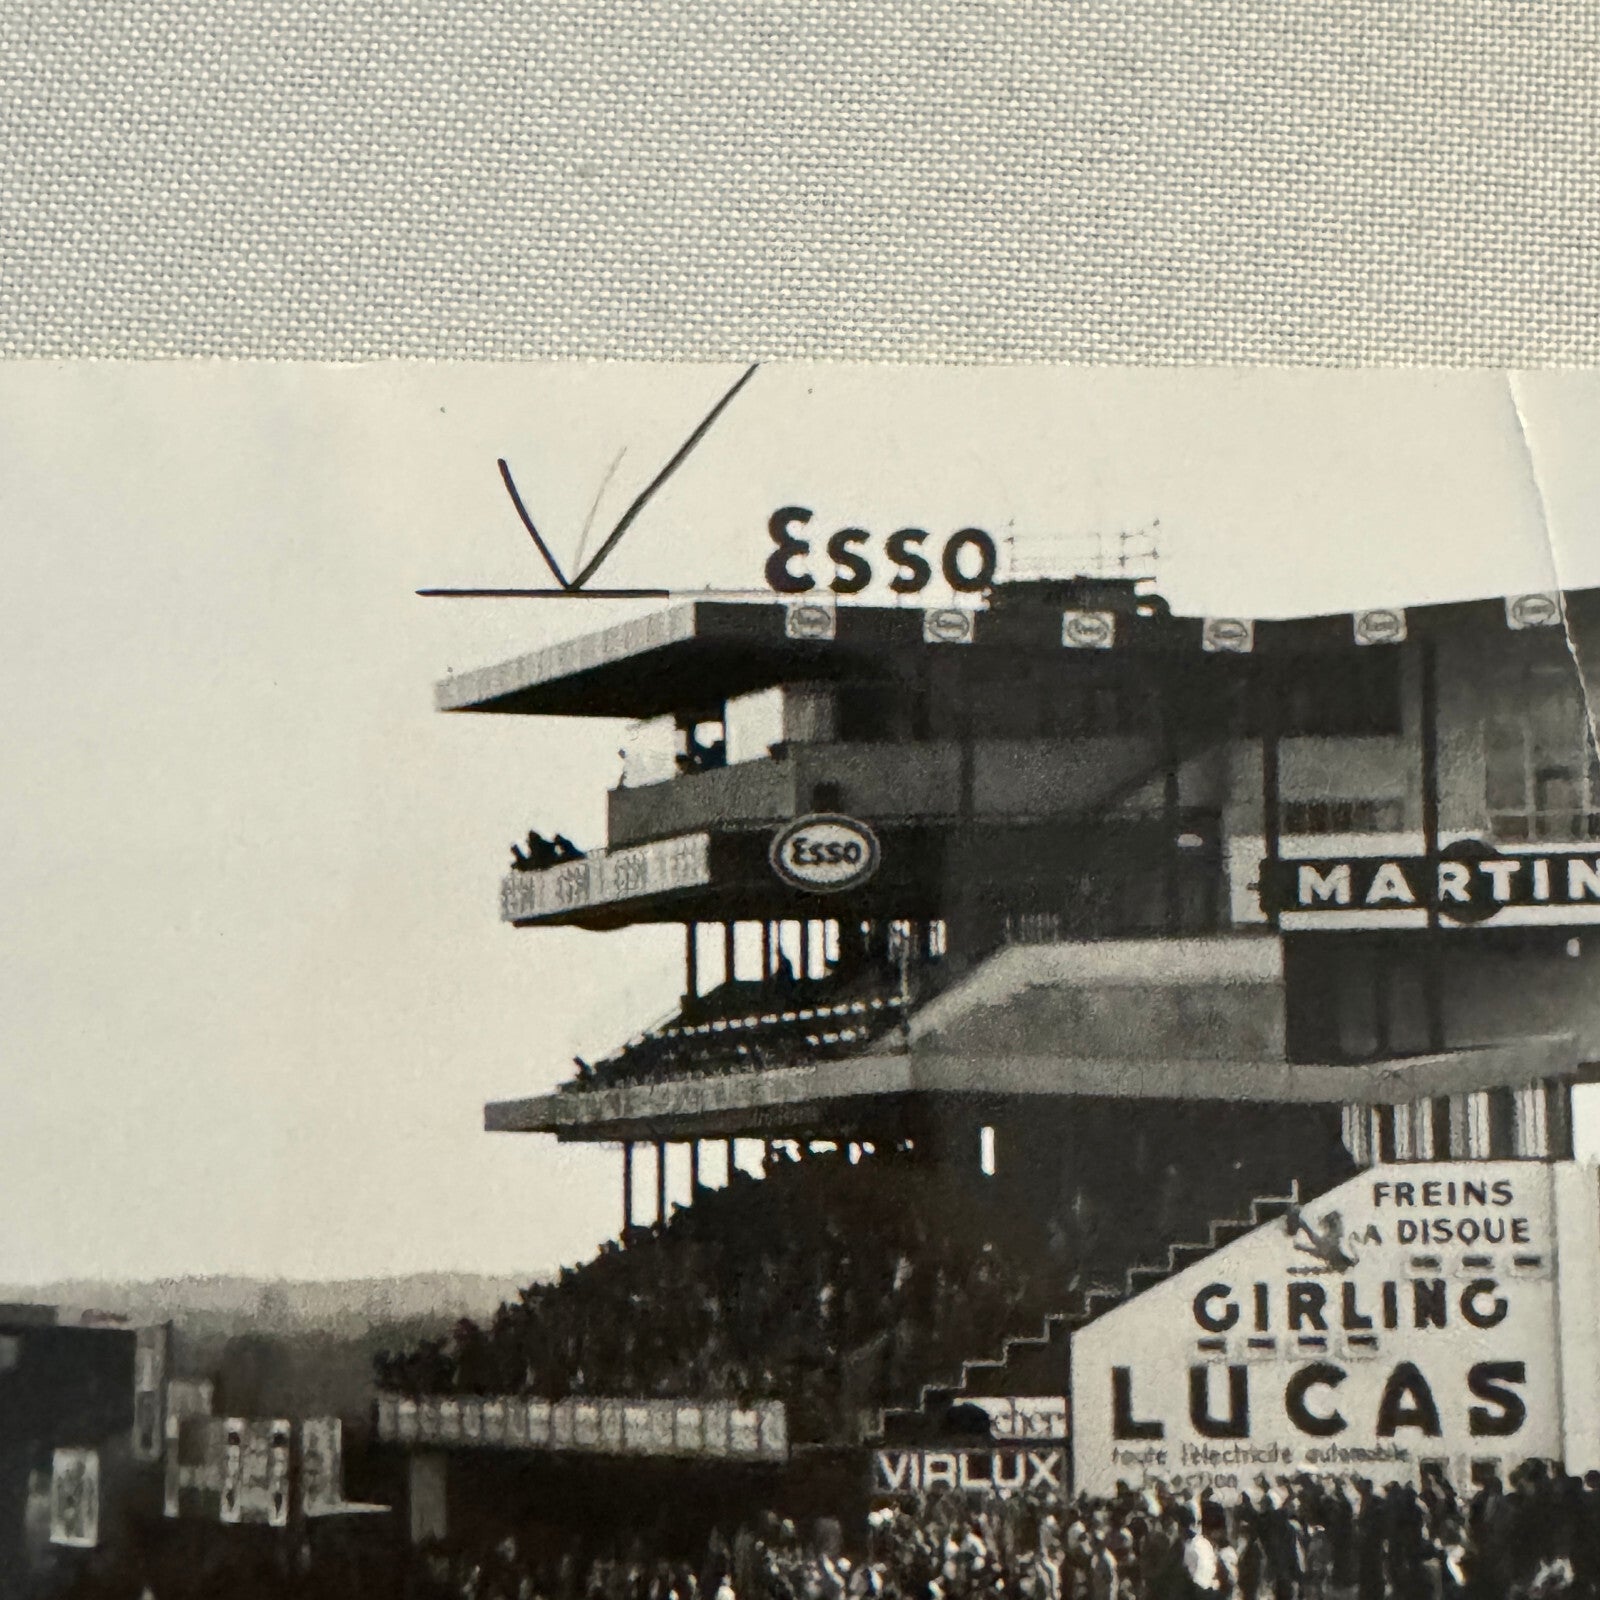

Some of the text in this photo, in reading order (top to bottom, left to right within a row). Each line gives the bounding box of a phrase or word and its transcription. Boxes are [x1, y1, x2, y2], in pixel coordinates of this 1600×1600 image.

[1373, 1179, 1514, 1208] FREINS
[1397, 1216, 1531, 1247] DISQUE
[1192, 1278, 1509, 1333] GIRLING
[1111, 1360, 1528, 1441] LUCAS
